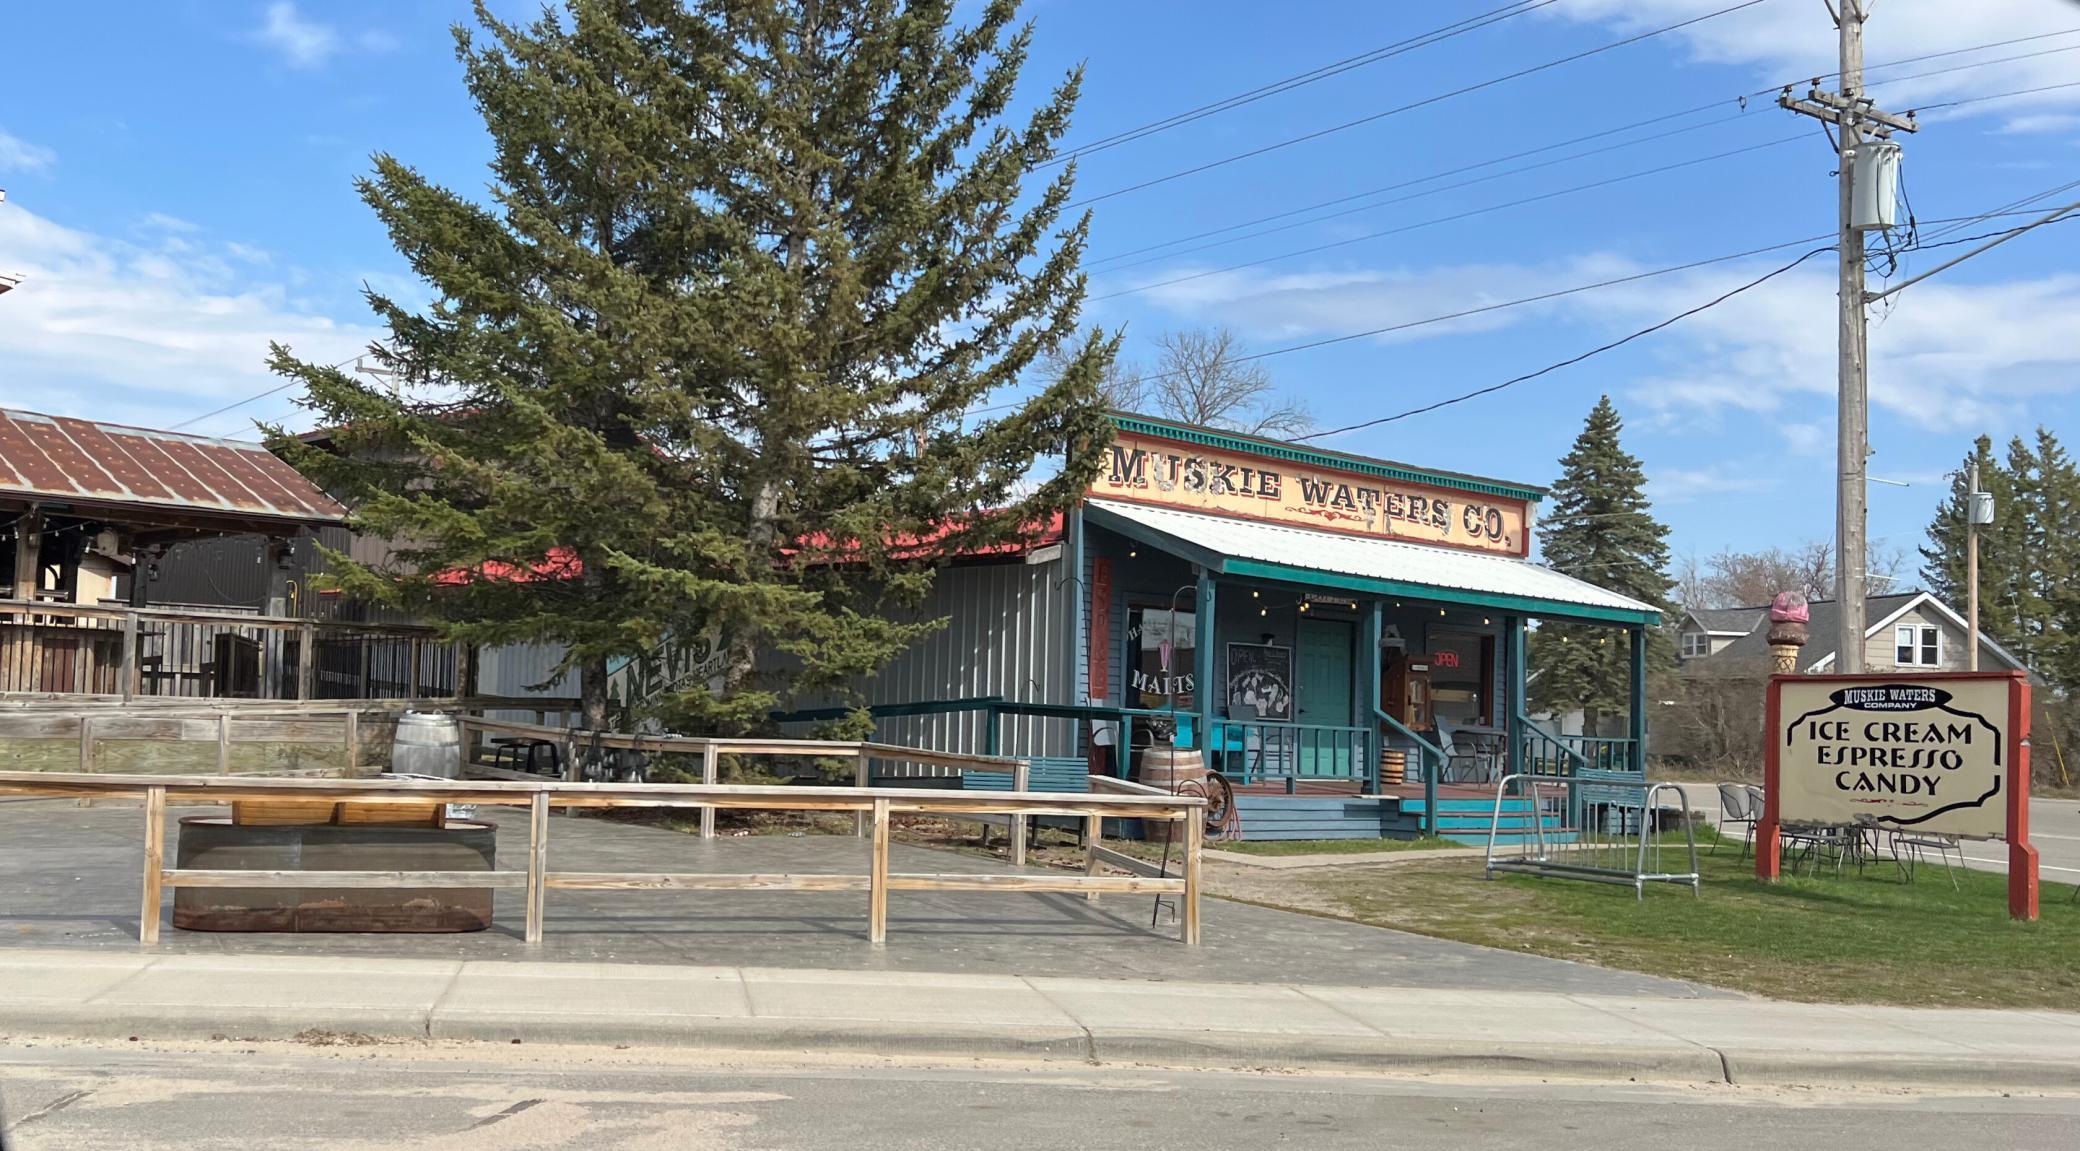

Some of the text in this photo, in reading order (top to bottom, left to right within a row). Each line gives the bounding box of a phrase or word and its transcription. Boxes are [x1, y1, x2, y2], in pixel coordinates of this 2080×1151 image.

[1108, 445, 1282, 501] MUSKIE
[1300, 477, 1451, 530] WATERS
[1434, 651, 1460, 668] OPEN
[1131, 669, 1195, 695] MALTS
[1843, 689, 1936, 705] MUSKIE WATERS
[1809, 721, 1972, 744] ICE CREAM
[1817, 746, 1963, 770] ESPRESSO
[1835, 771, 1941, 796] CANDY
